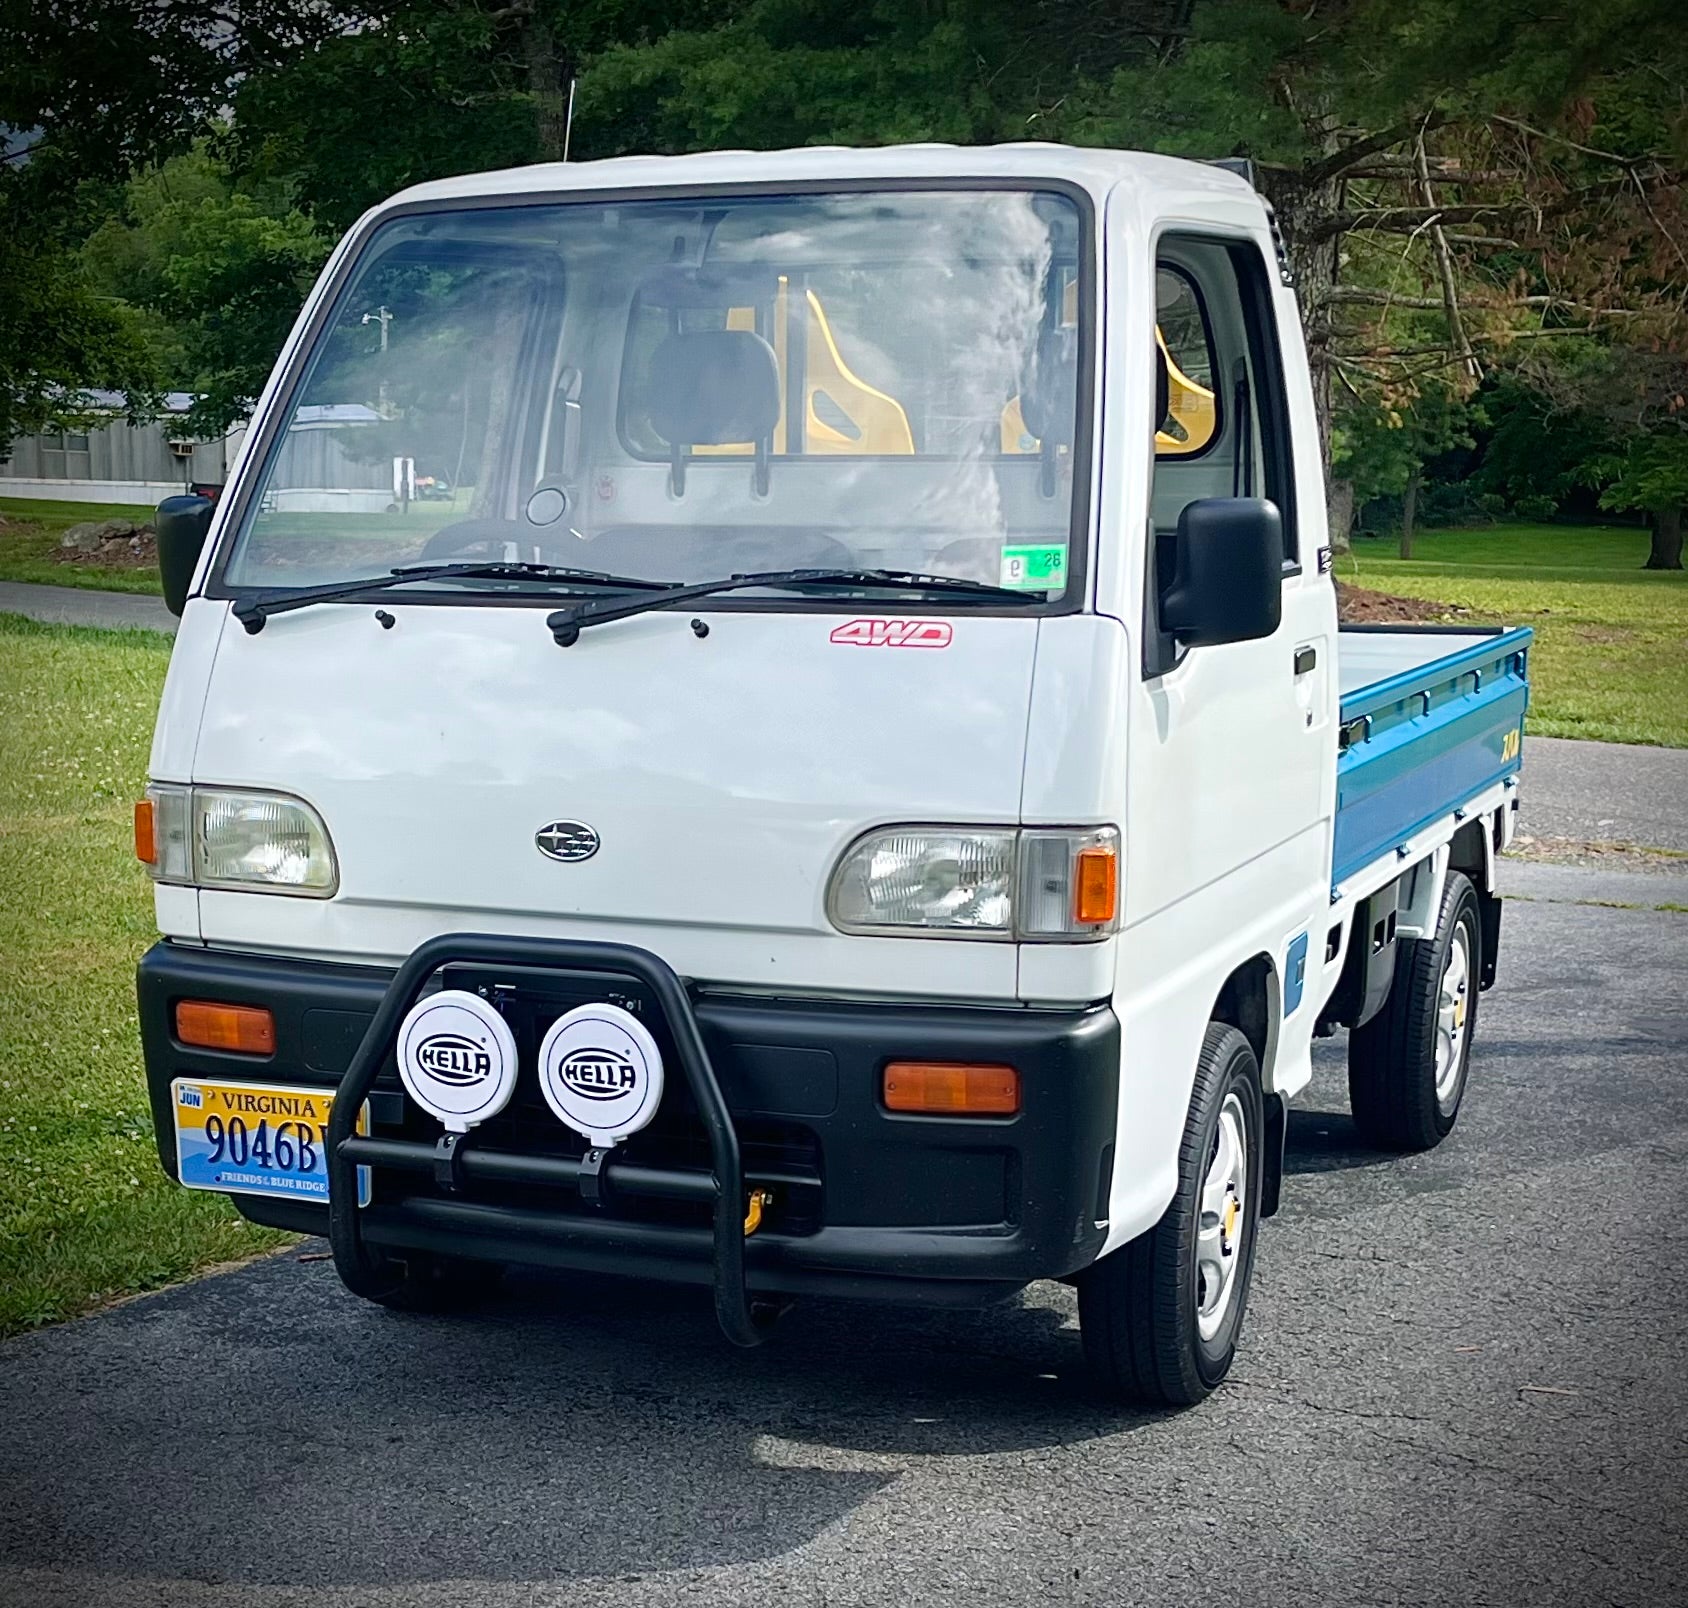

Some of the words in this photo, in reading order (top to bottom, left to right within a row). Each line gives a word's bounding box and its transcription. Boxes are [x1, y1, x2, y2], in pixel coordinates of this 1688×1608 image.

[830, 619, 952, 648] 4WD
[422, 1048, 491, 1077] HELLA
[564, 1063, 636, 1090] HELLA
[179, 1092, 201, 1107] JUN
[221, 1091, 318, 1118] VIRGINIA
[221, 1171, 261, 1185] FRIENDS
[270, 1176, 295, 1188] BLUE
[295, 1179, 326, 1192] RIDGE
